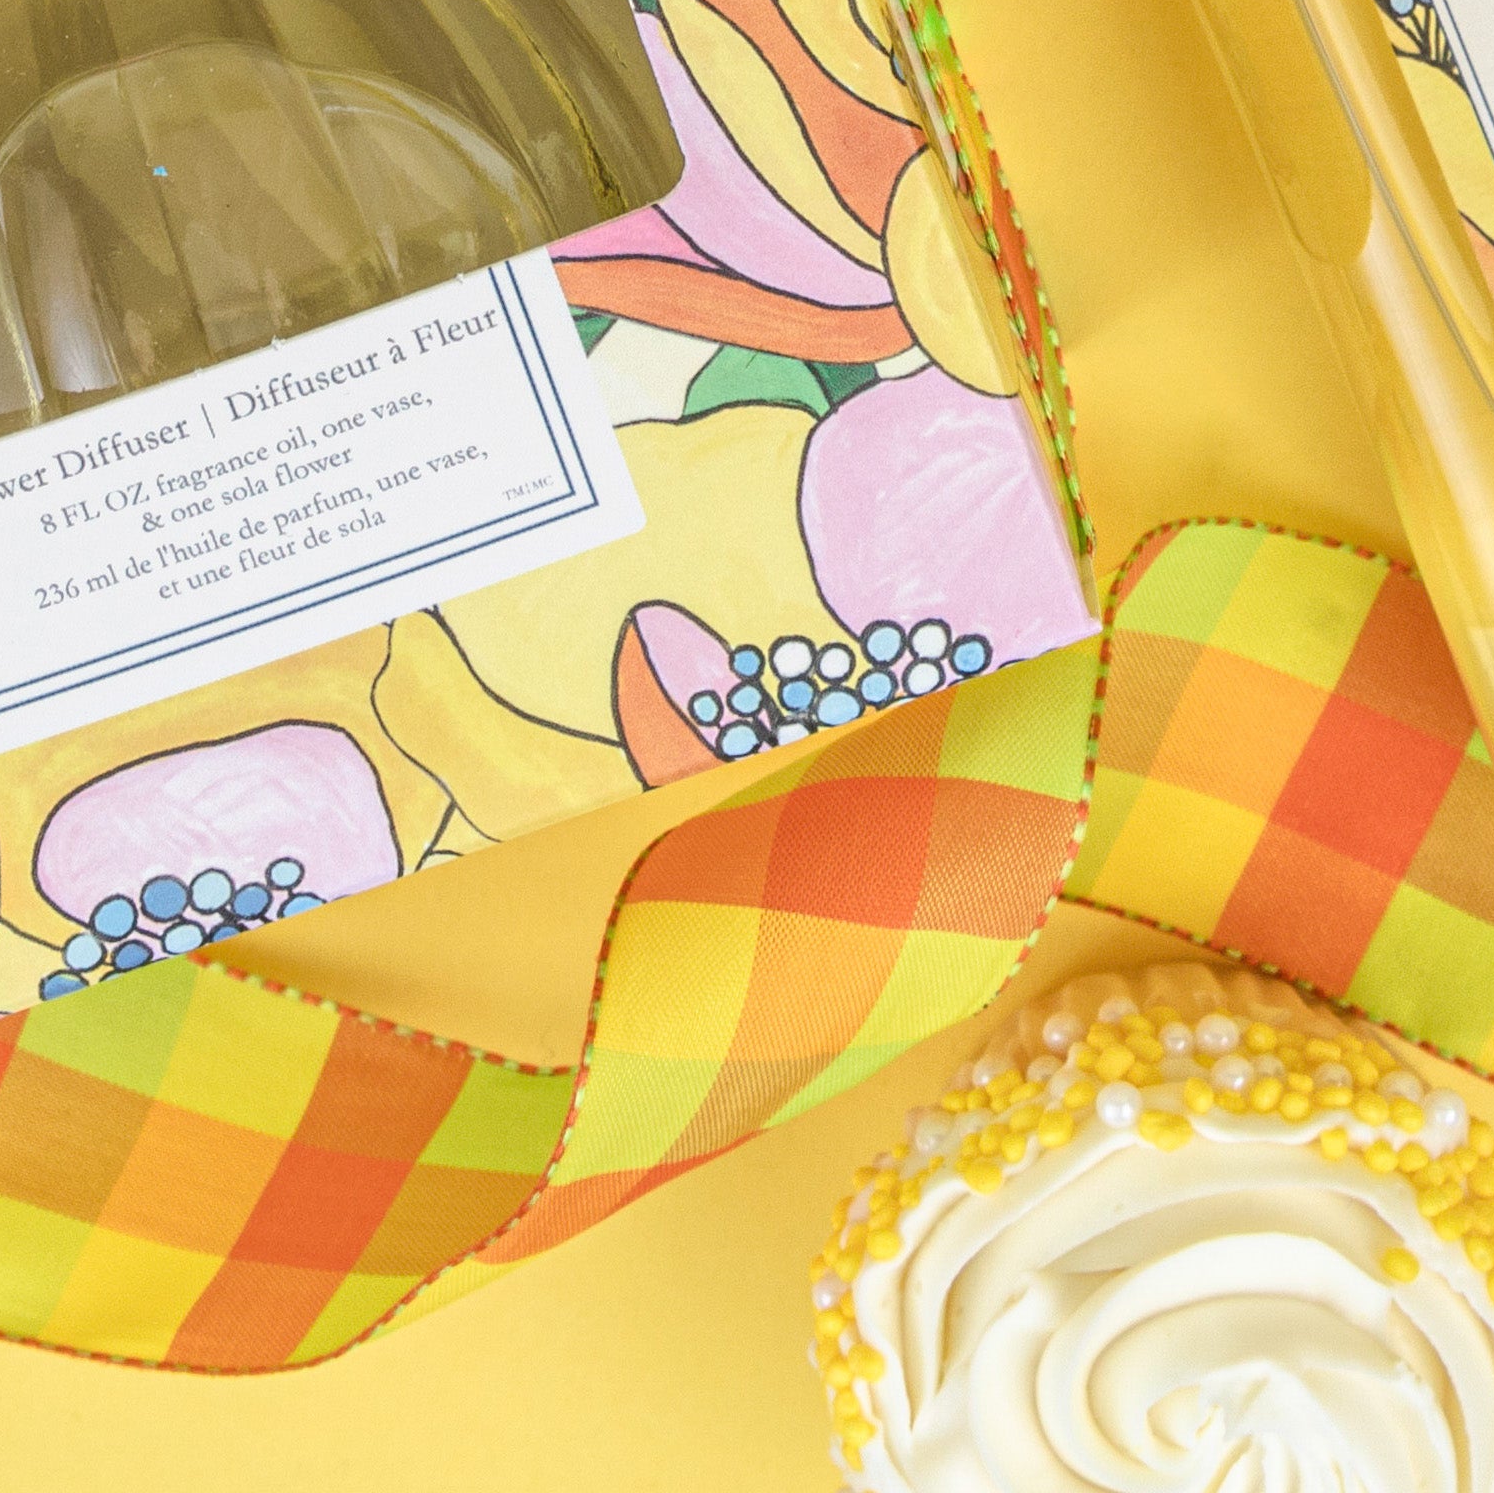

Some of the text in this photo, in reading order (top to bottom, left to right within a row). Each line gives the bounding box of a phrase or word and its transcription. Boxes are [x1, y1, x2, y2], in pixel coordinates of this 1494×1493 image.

[38, 391, 433, 535] 8 FL OZ fragrance oil, one vase,
[52, 418, 190, 480] Diffuser
[223, 351, 378, 422] Diffuseur
[386, 336, 407, 365] à
[411, 308, 496, 354] Fleur
[33, 444, 488, 610] 236 ml de l'huile de parfum, une vase,
[141, 447, 351, 533] & one sola flower
[157, 506, 386, 600] et une fleur de sola
